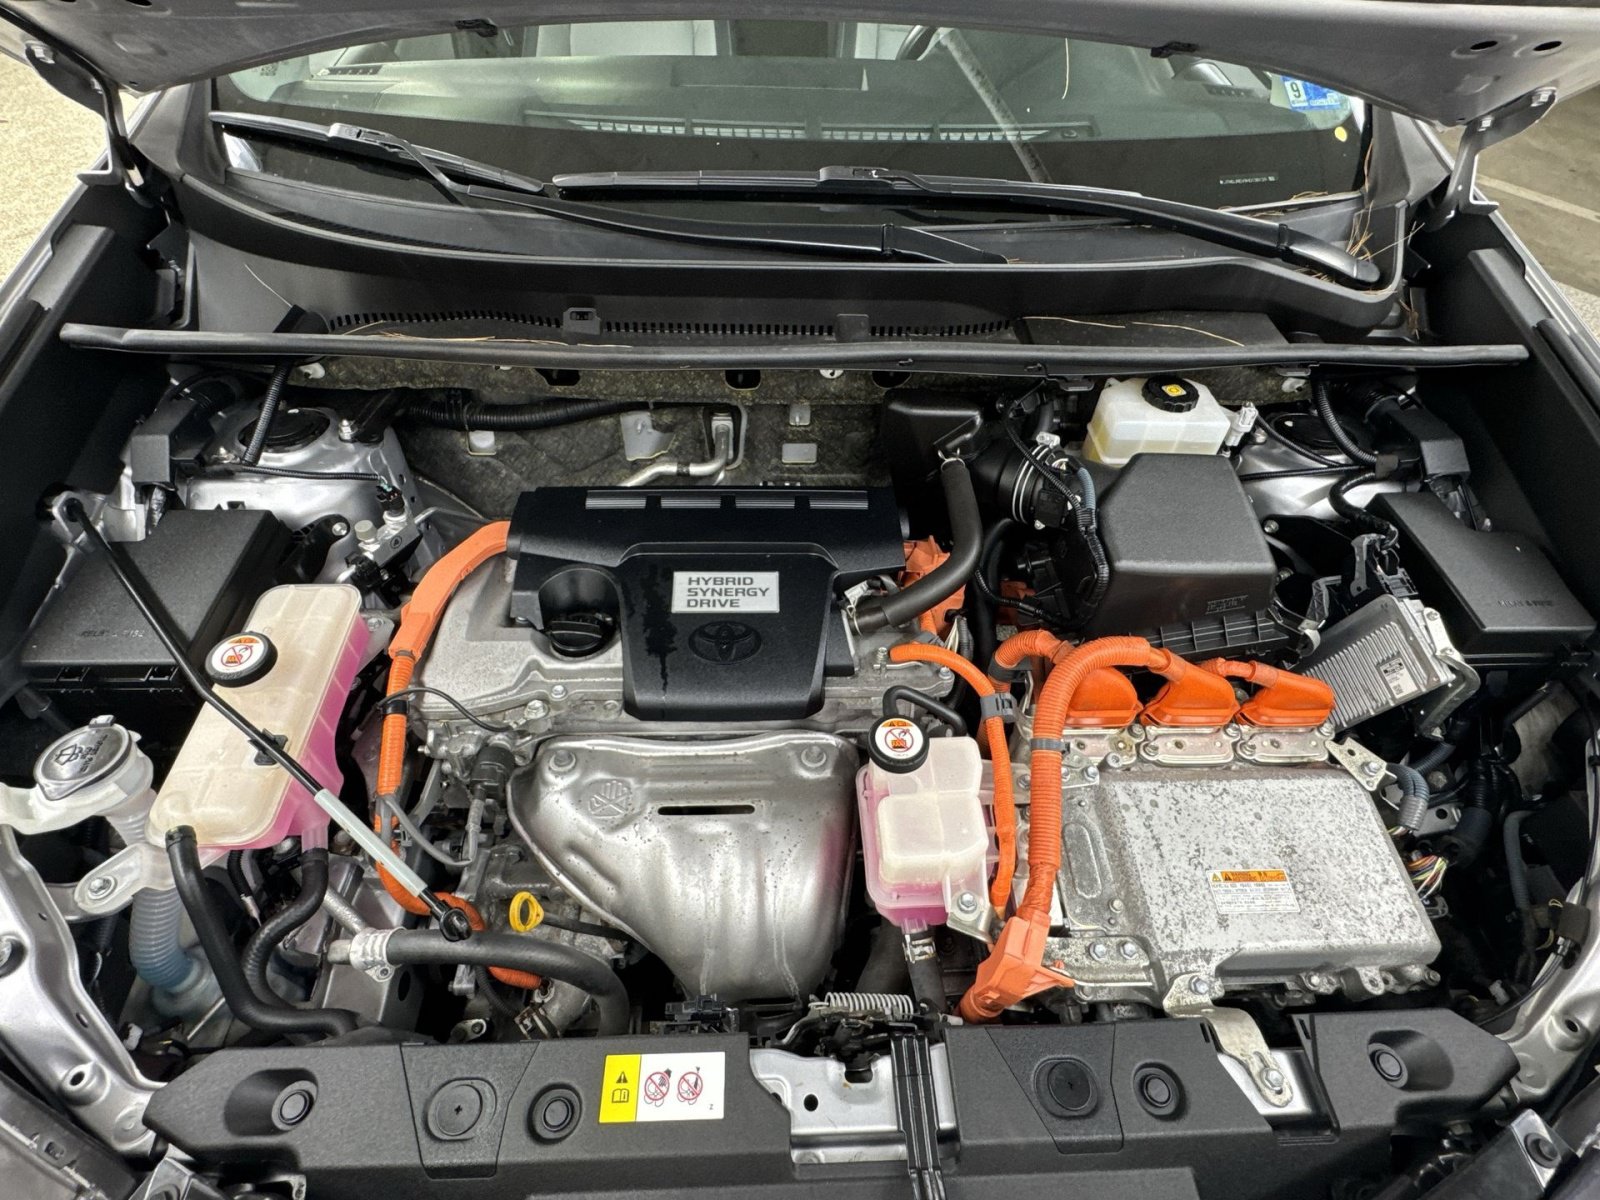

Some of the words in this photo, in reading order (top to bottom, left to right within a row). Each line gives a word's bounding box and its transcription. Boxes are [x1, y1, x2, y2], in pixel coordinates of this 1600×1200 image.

[1290, 81, 1301, 98] 9
[688, 576, 754, 586] HYBRID
[687, 587, 770, 597] SYNERGY
[686, 598, 741, 608] DRIVE
